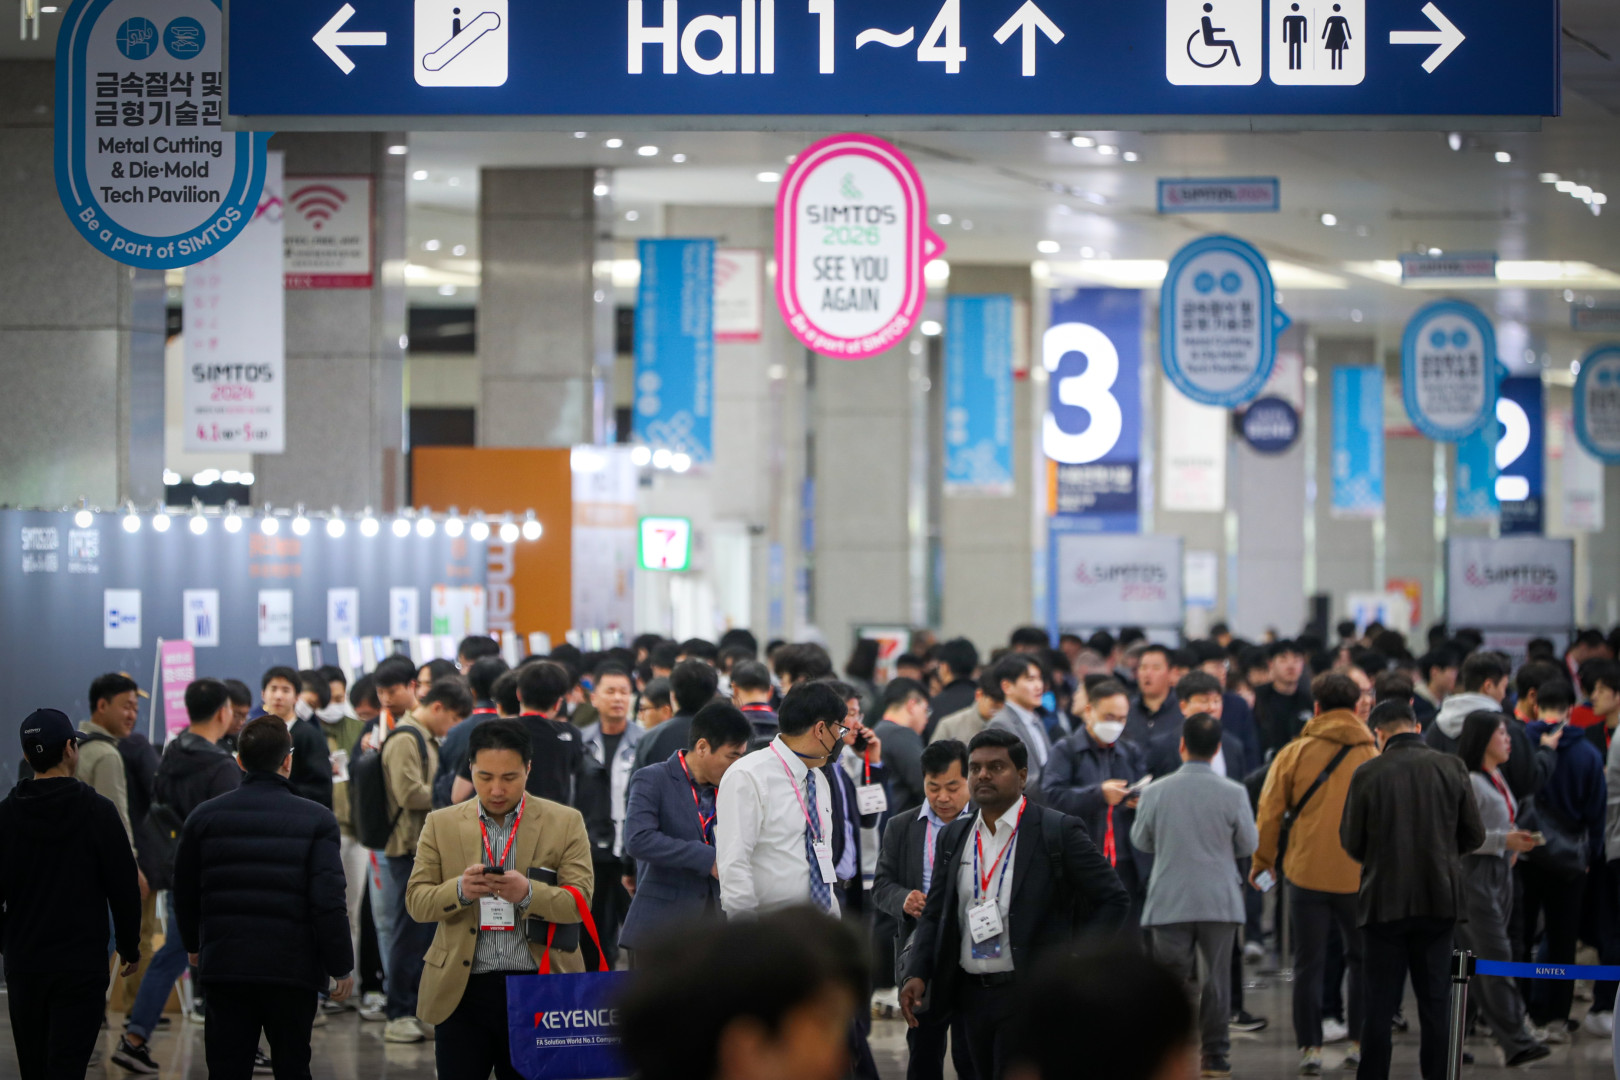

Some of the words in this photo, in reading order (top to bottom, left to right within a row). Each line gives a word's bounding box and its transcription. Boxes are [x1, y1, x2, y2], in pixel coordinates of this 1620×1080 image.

[627, 0, 775, 75] Hall
[96, 72, 194, 98] 금속절삭
[202, 72, 221, 98] 및
[95, 100, 221, 127] 금형기술관
[98, 136, 149, 154] Metal
[153, 136, 223, 158] Cutting
[111, 161, 125, 179] &
[100, 186, 144, 203] Tech
[148, 185, 220, 203] Pavilion
[805, 204, 898, 225] SIMTOS
[78, 206, 100, 231] Be
[100, 229, 113, 242] a
[110, 237, 153, 258] part
[156, 242, 175, 259] of
[177, 206, 242, 255] SIMTOS
[822, 225, 882, 246] 2026
[812, 255, 846, 282] SEE
[851, 255, 889, 283] YOU
[820, 285, 880, 313] AGAIN
[192, 362, 274, 383] SIMTOS
[1043, 321, 1123, 465] 3
[1535, 967, 1566, 976] KINTEX
[534, 1008, 619, 1029] KEYENCE
[544, 1038, 566, 1046] Solution
[566, 1037, 582, 1045] World
[582, 1036, 595, 1044] No.1
